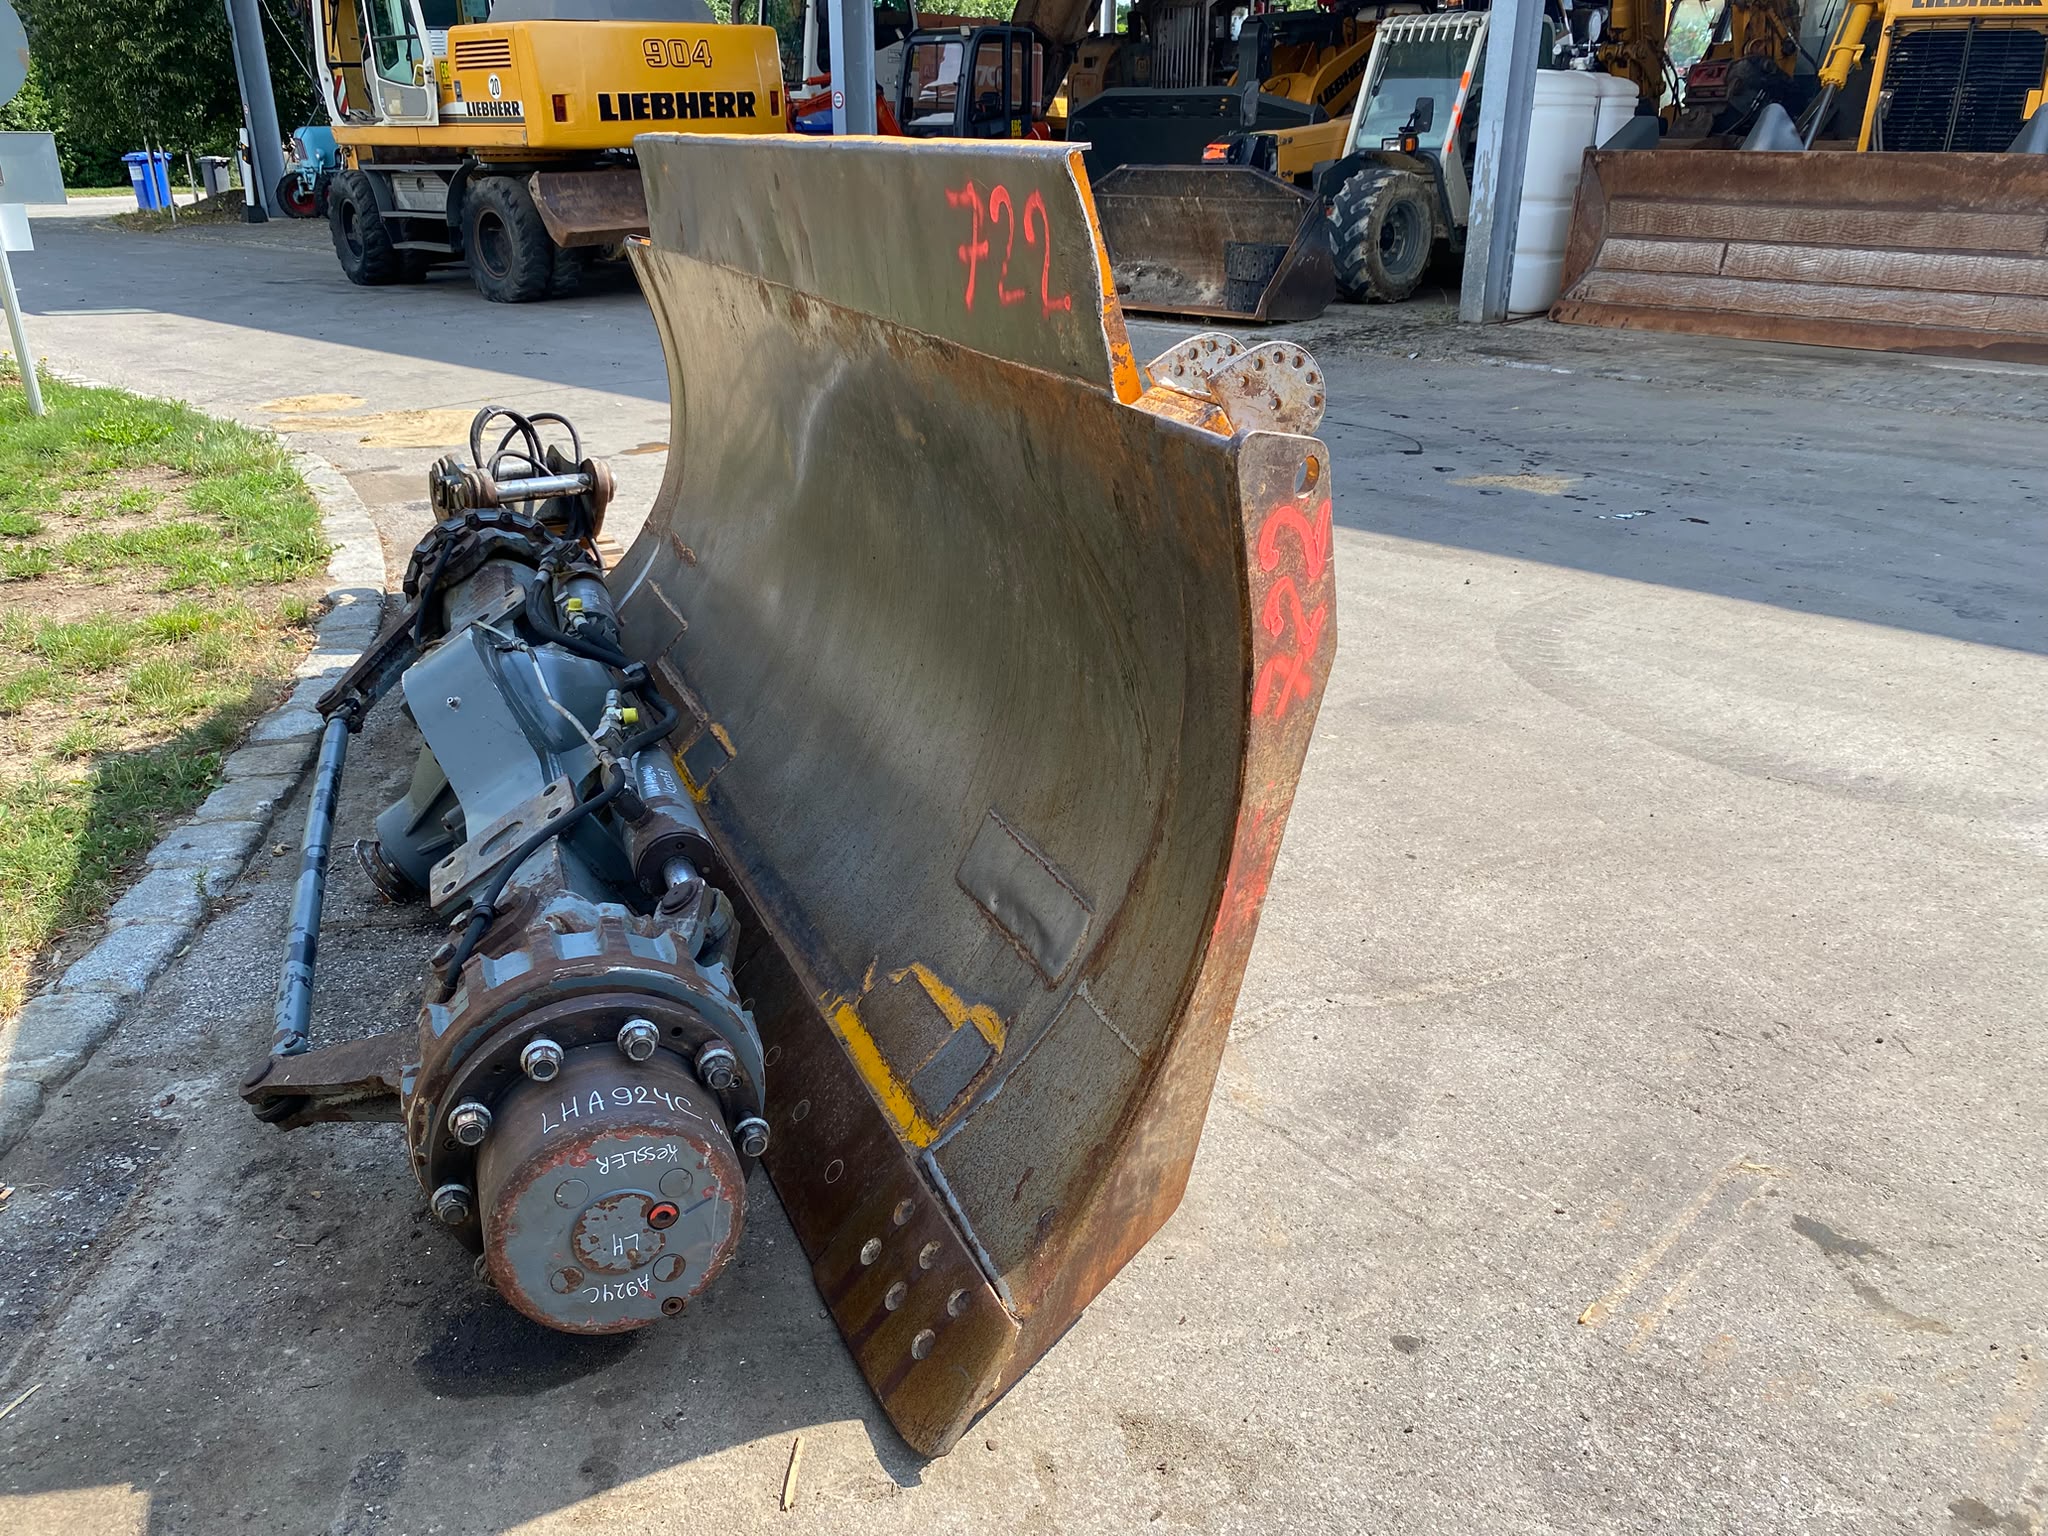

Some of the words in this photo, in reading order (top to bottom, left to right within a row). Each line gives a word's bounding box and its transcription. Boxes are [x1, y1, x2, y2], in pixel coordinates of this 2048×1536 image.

[642, 38, 713, 68] 904
[489, 78, 500, 96] 20
[466, 101, 521, 117] LIEBHERR
[598, 90, 757, 121] LIEBHERR
[1252, 498, 1332, 720] 722
[612, 1233, 639, 1257] LH
[582, 1274, 650, 1303] A924C
